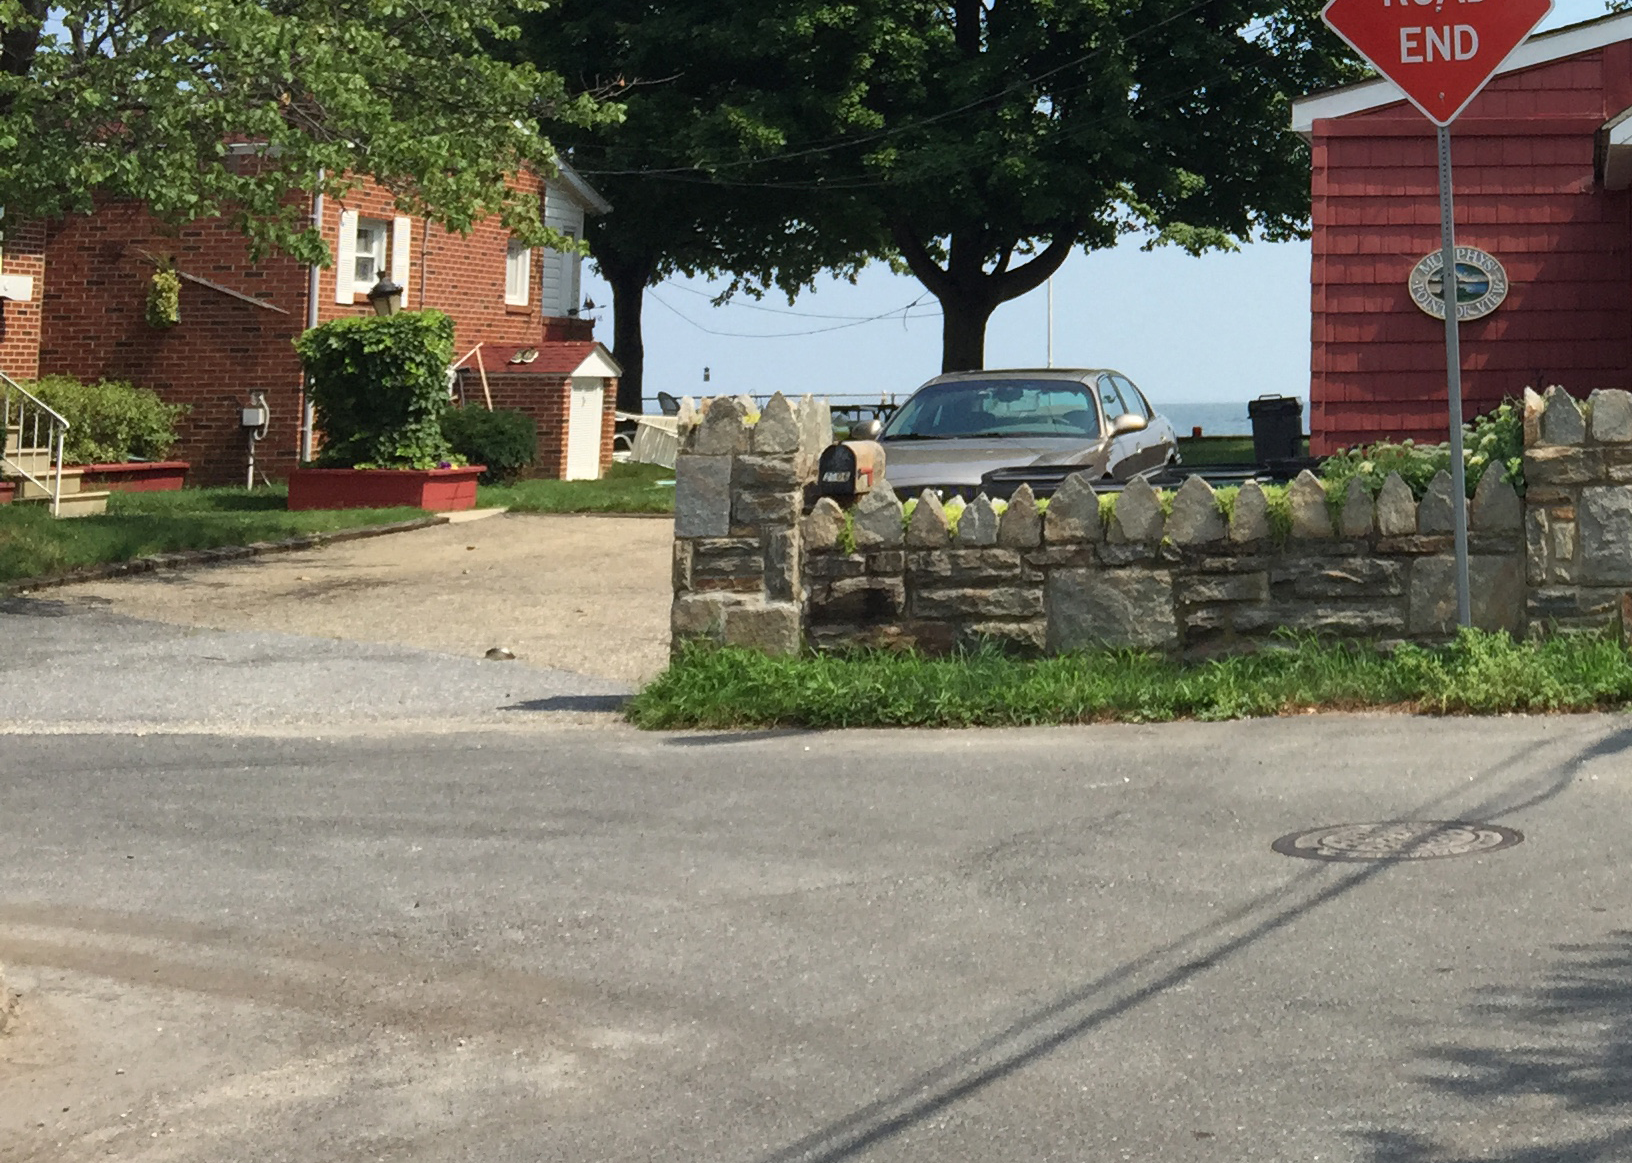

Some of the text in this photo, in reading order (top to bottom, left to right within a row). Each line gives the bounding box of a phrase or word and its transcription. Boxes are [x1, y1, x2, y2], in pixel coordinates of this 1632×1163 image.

[1399, 24, 1480, 64] END
[1418, 248, 1499, 275] MUPHYS'
[1412, 281, 1447, 317] POINT
[1475, 279, 1505, 313] VIEW
